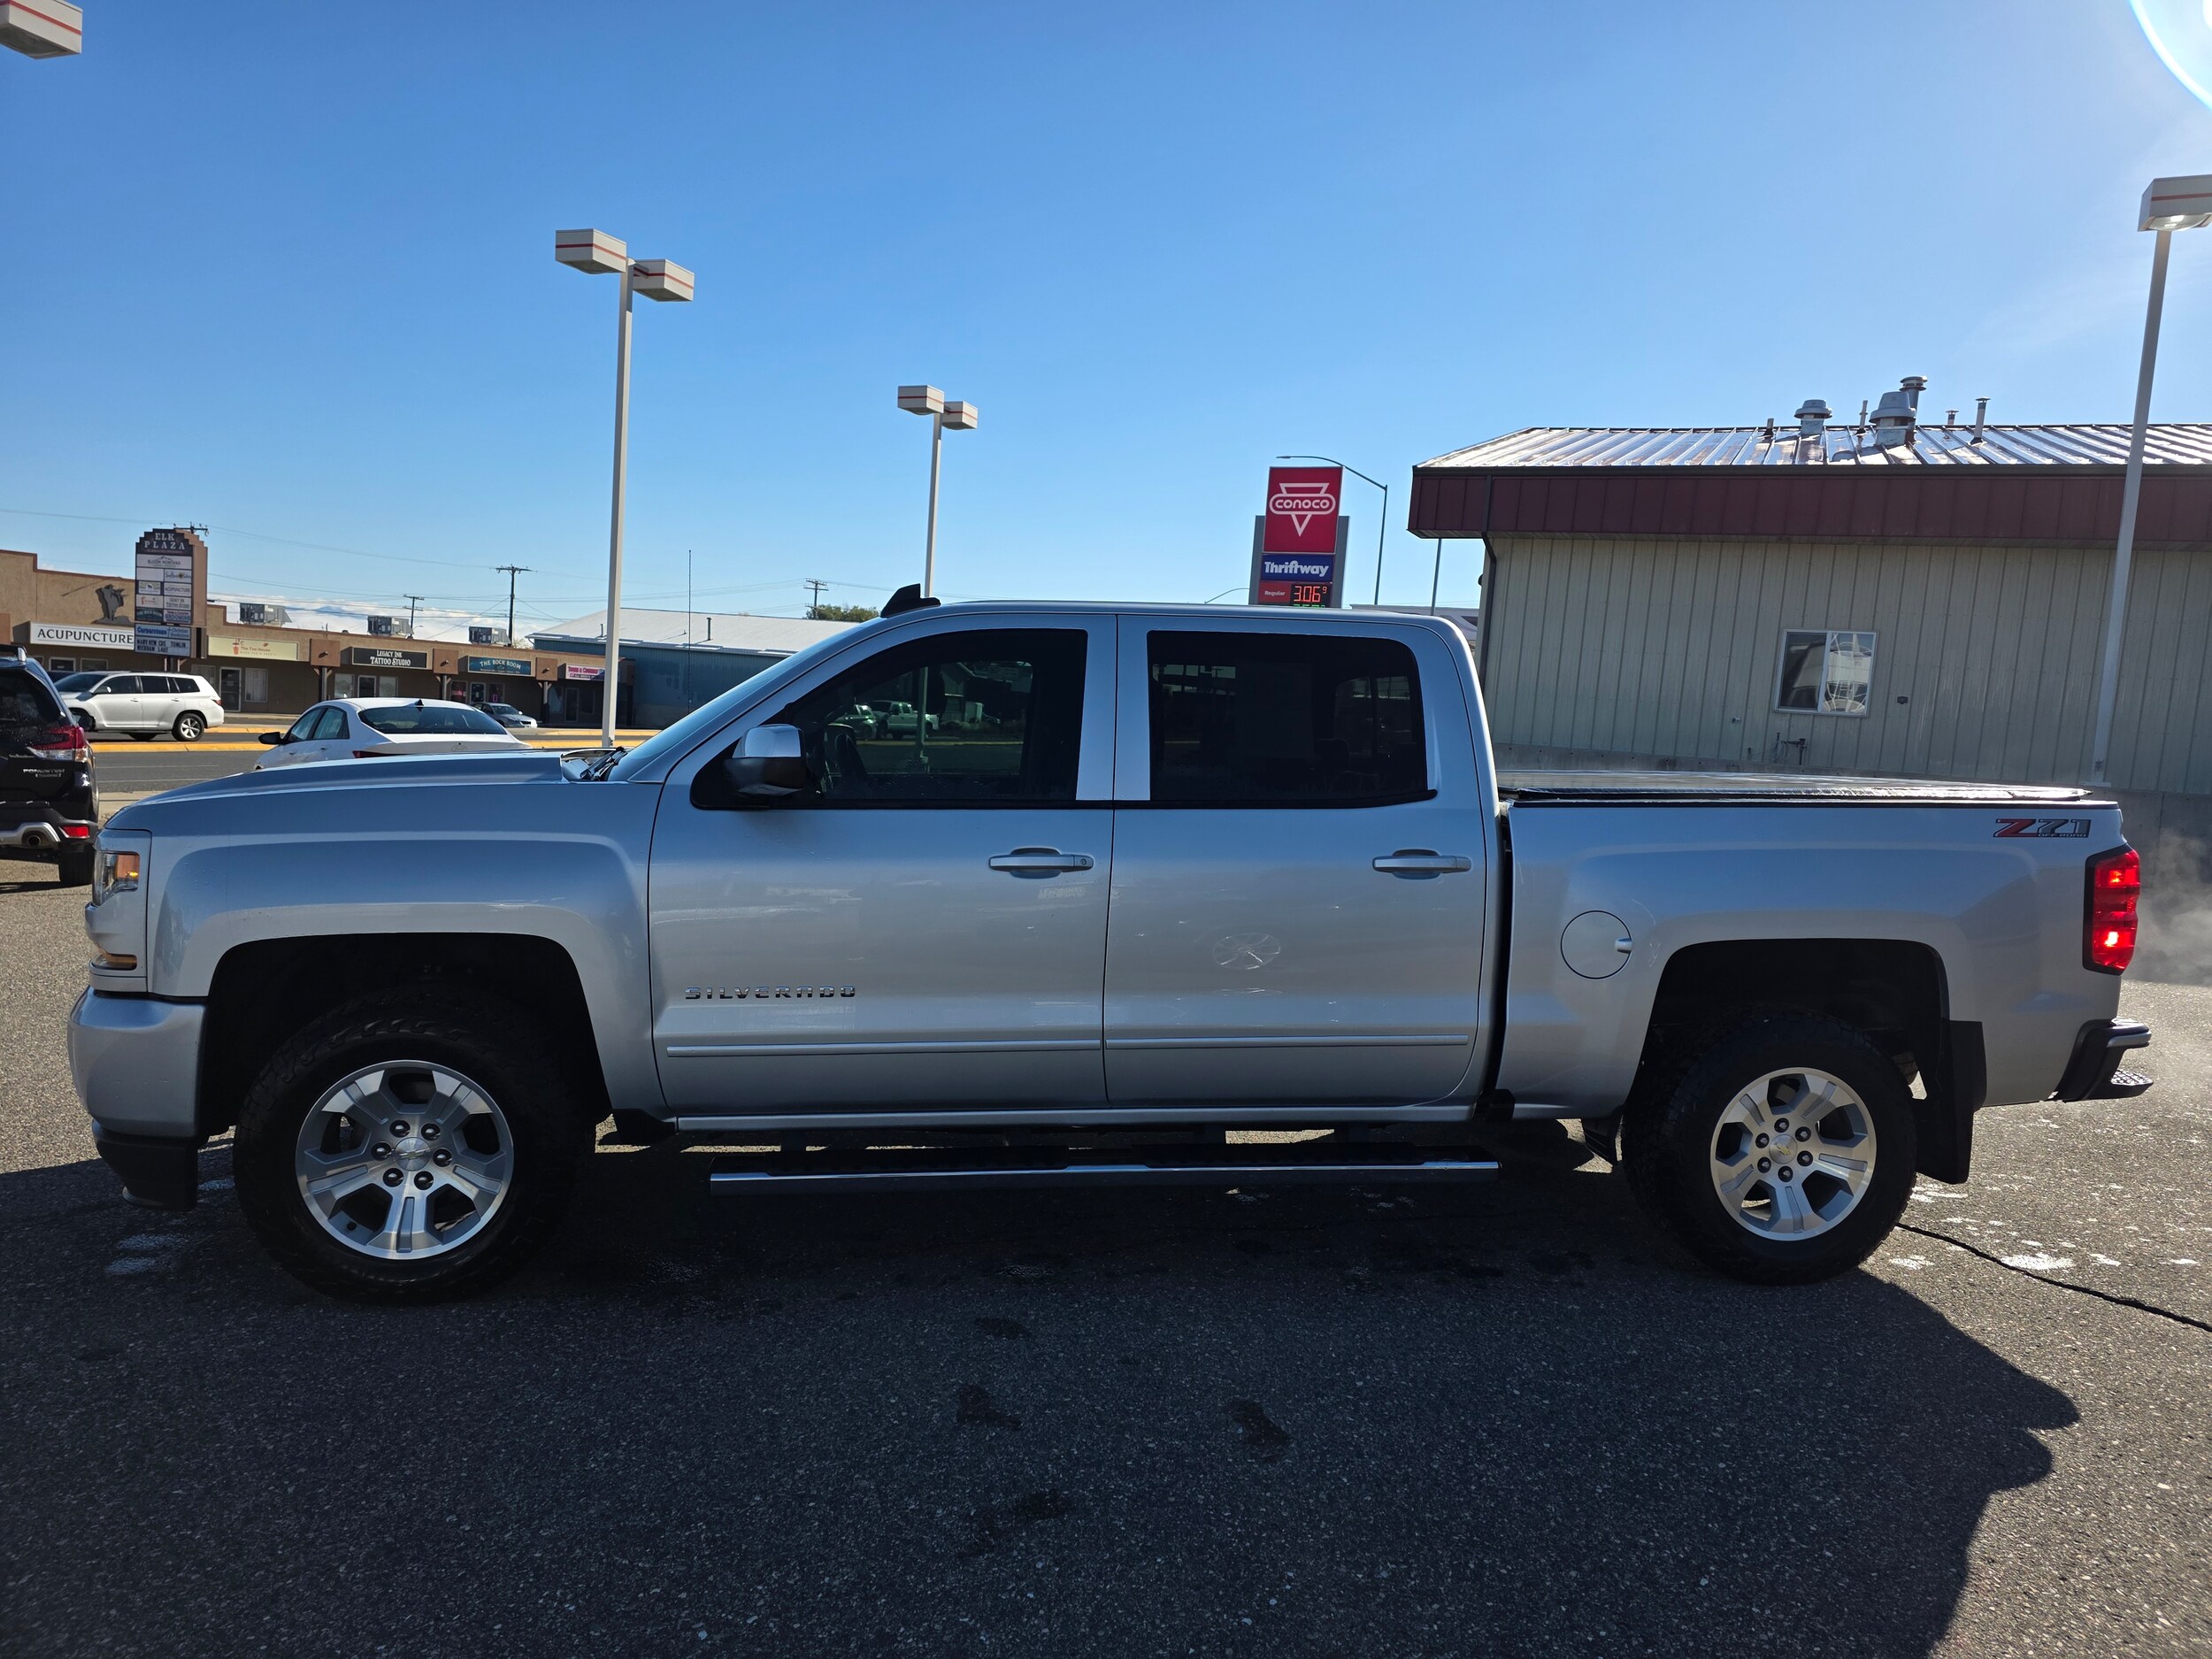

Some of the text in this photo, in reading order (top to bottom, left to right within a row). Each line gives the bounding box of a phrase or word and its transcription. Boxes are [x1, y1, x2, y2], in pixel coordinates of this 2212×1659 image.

[144, 541, 185, 549] PLAZA
[1264, 560, 1329, 577] Thriftway
[37, 628, 134, 644] ACUPUNCTURE
[370, 656, 411, 666] TATTOO STUDIO
[506, 660, 521, 670] ROOM
[1993, 818, 2092, 838] Z71
[685, 985, 856, 1000] SILVERADO
